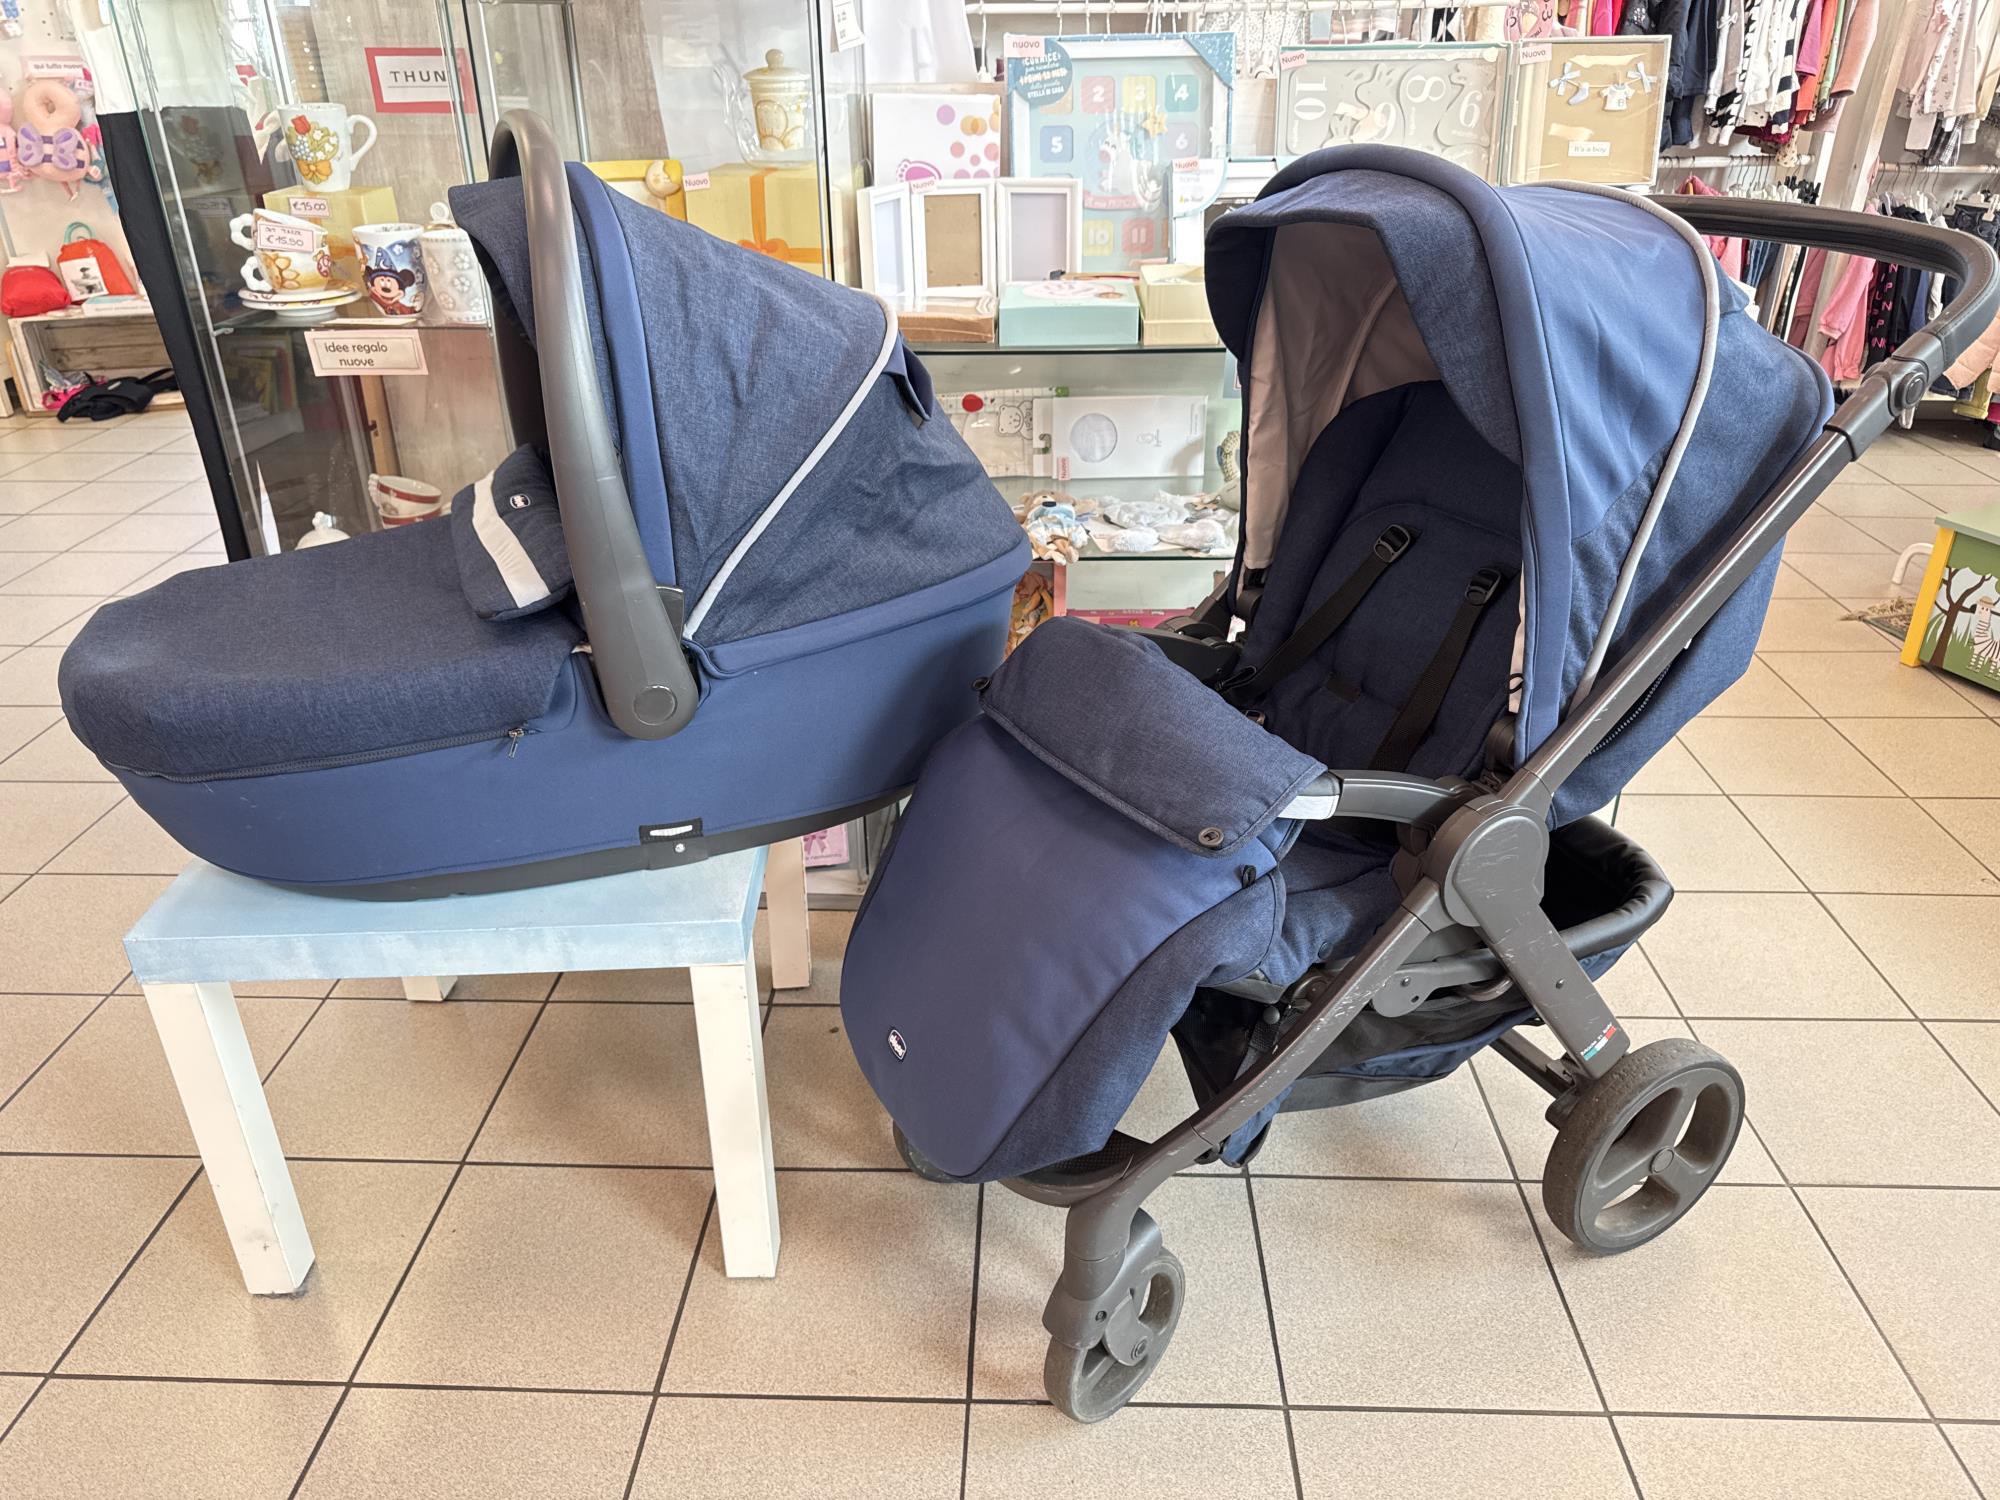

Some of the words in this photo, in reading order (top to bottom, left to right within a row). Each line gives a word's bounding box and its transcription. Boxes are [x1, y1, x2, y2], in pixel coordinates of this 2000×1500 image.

[1282, 53, 1304, 64] Nuovo
[1522, 50, 1546, 59] Nuovo
[389, 71, 446, 82] THUN
[1092, 85, 1105, 102] 2
[1135, 84, 1147, 100] 3
[1175, 83, 1189, 102] 4
[1459, 90, 1483, 128] 6
[1050, 136, 1063, 153] 5
[1176, 133, 1188, 150] 6
[1175, 161, 1197, 169] Nuovo
[685, 179, 708, 187] Nuovo
[912, 180, 935, 189] Nuovo
[1088, 228, 1109, 245] 10
[1132, 227, 1146, 244] 11
[324, 341, 349, 353] idee
[352, 341, 388, 354] regalo
[339, 358, 374, 367] nuove
